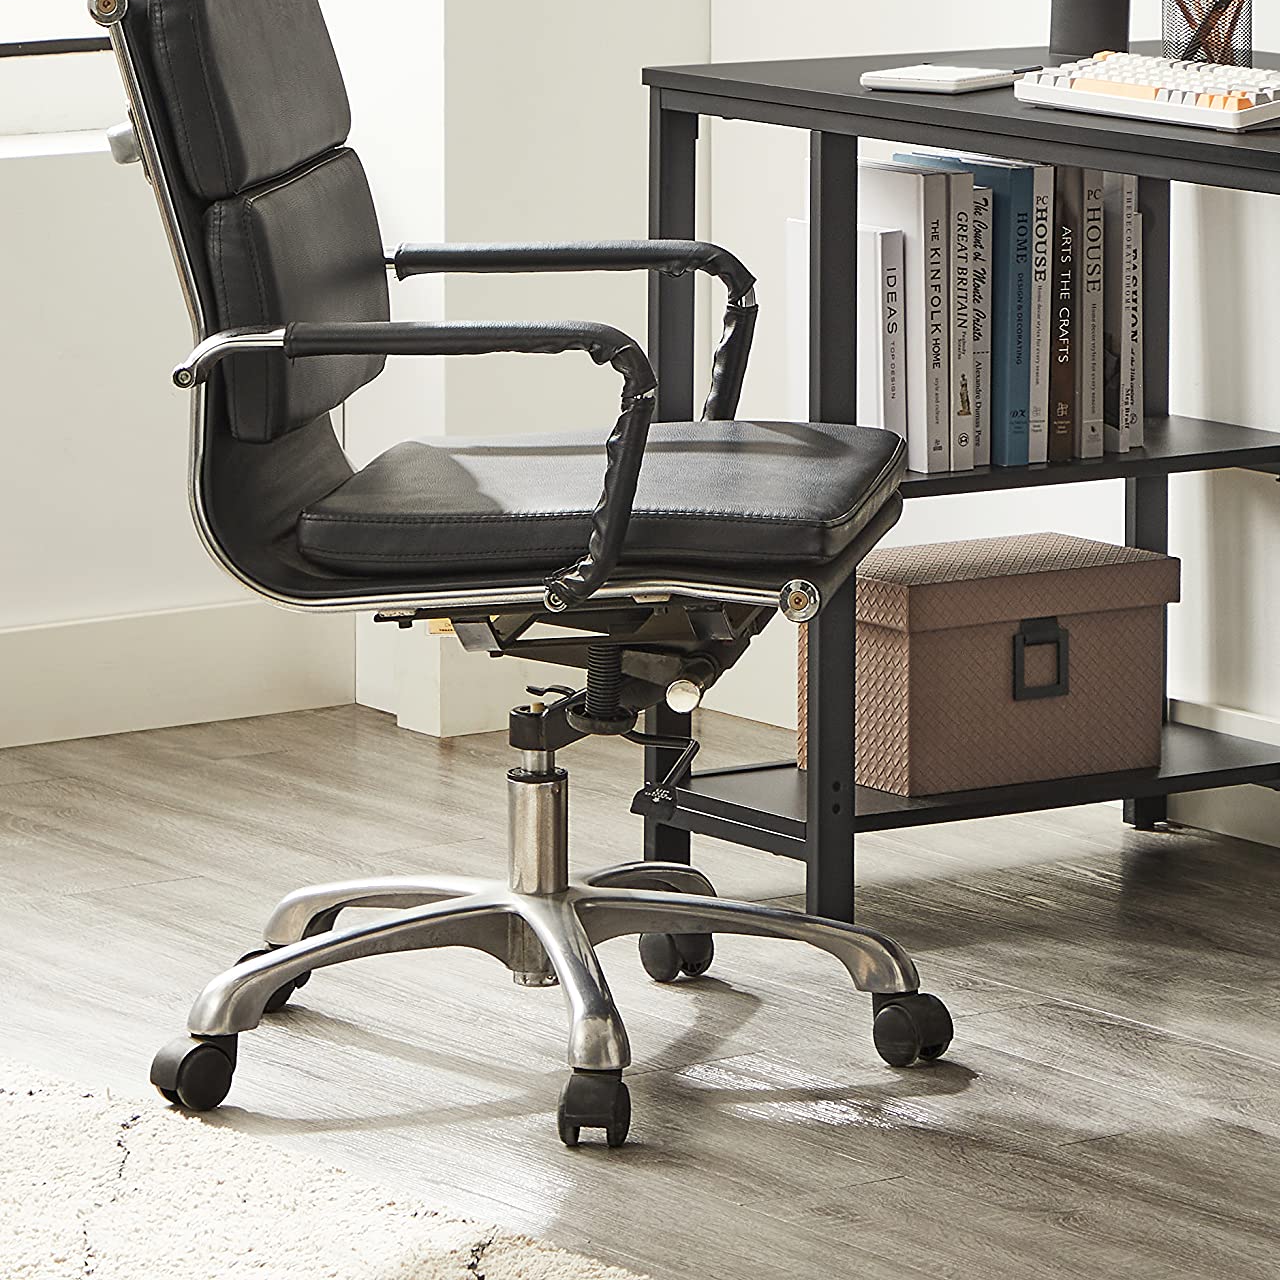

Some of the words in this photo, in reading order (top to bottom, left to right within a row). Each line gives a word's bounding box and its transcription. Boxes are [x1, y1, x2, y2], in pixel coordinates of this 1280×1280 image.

[974, 197, 988, 216] The
[1036, 196, 1048, 205] PC
[1088, 189, 1101, 200] PC
[931, 219, 940, 241] THE
[957, 212, 968, 263] GREAT
[973, 220, 988, 249] Count
[1016, 212, 1028, 264] HOME
[1034, 207, 1048, 282] HOUSE
[1060, 226, 1072, 263] ARTS
[1086, 206, 1101, 292] HOUSE
[886, 267, 897, 334] IDEAS
[930, 247, 941, 334] KINFOLK
[957, 267, 968, 328] BRITAIN
[973, 268, 986, 304] Monte
[1060, 271, 1071, 300] THE
[973, 308, 986, 341] Cristo
[1058, 307, 1071, 363] CRAFTS
